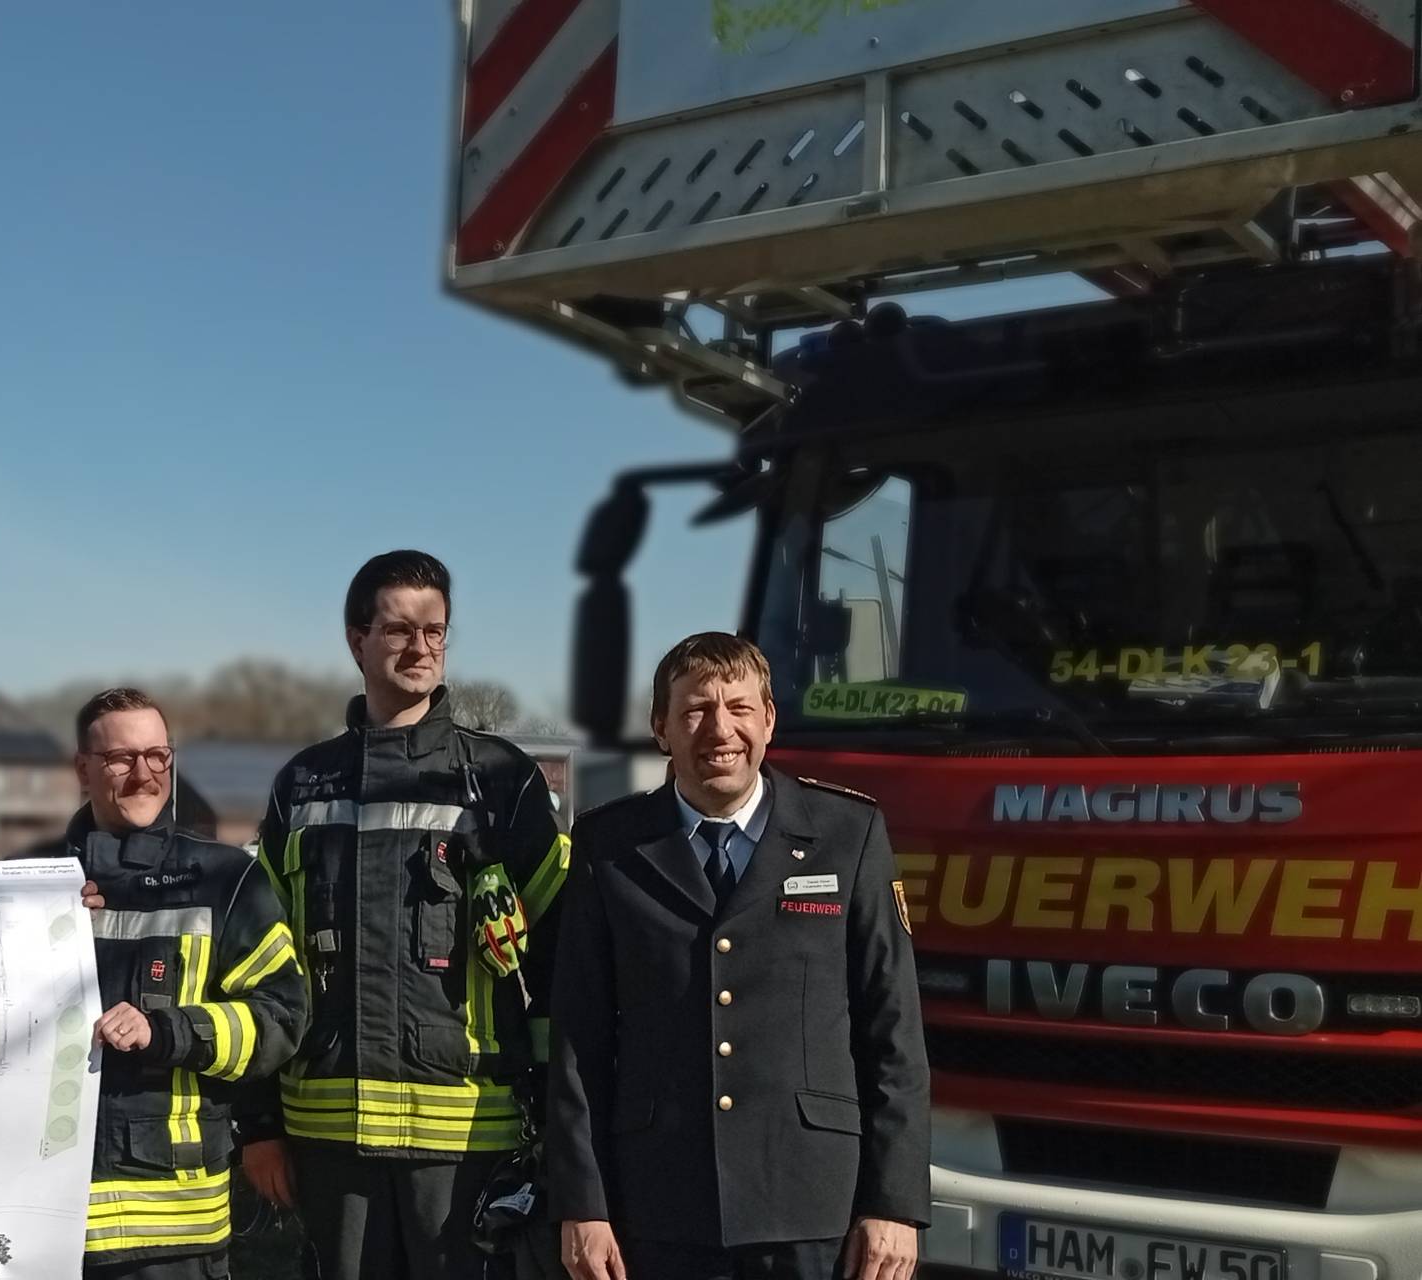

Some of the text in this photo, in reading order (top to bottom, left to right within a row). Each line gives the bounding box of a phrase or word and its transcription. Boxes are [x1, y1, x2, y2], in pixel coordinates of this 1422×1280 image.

[992, 782, 1304, 824] MAGIRUS
[780, 901, 842, 915] FEUERWEHR
[985, 958, 1327, 1036] IVECO
[1009, 1247, 1018, 1260] D
[1027, 1224, 1115, 1276] HAM
[1219, 1250, 1279, 1280] 50
